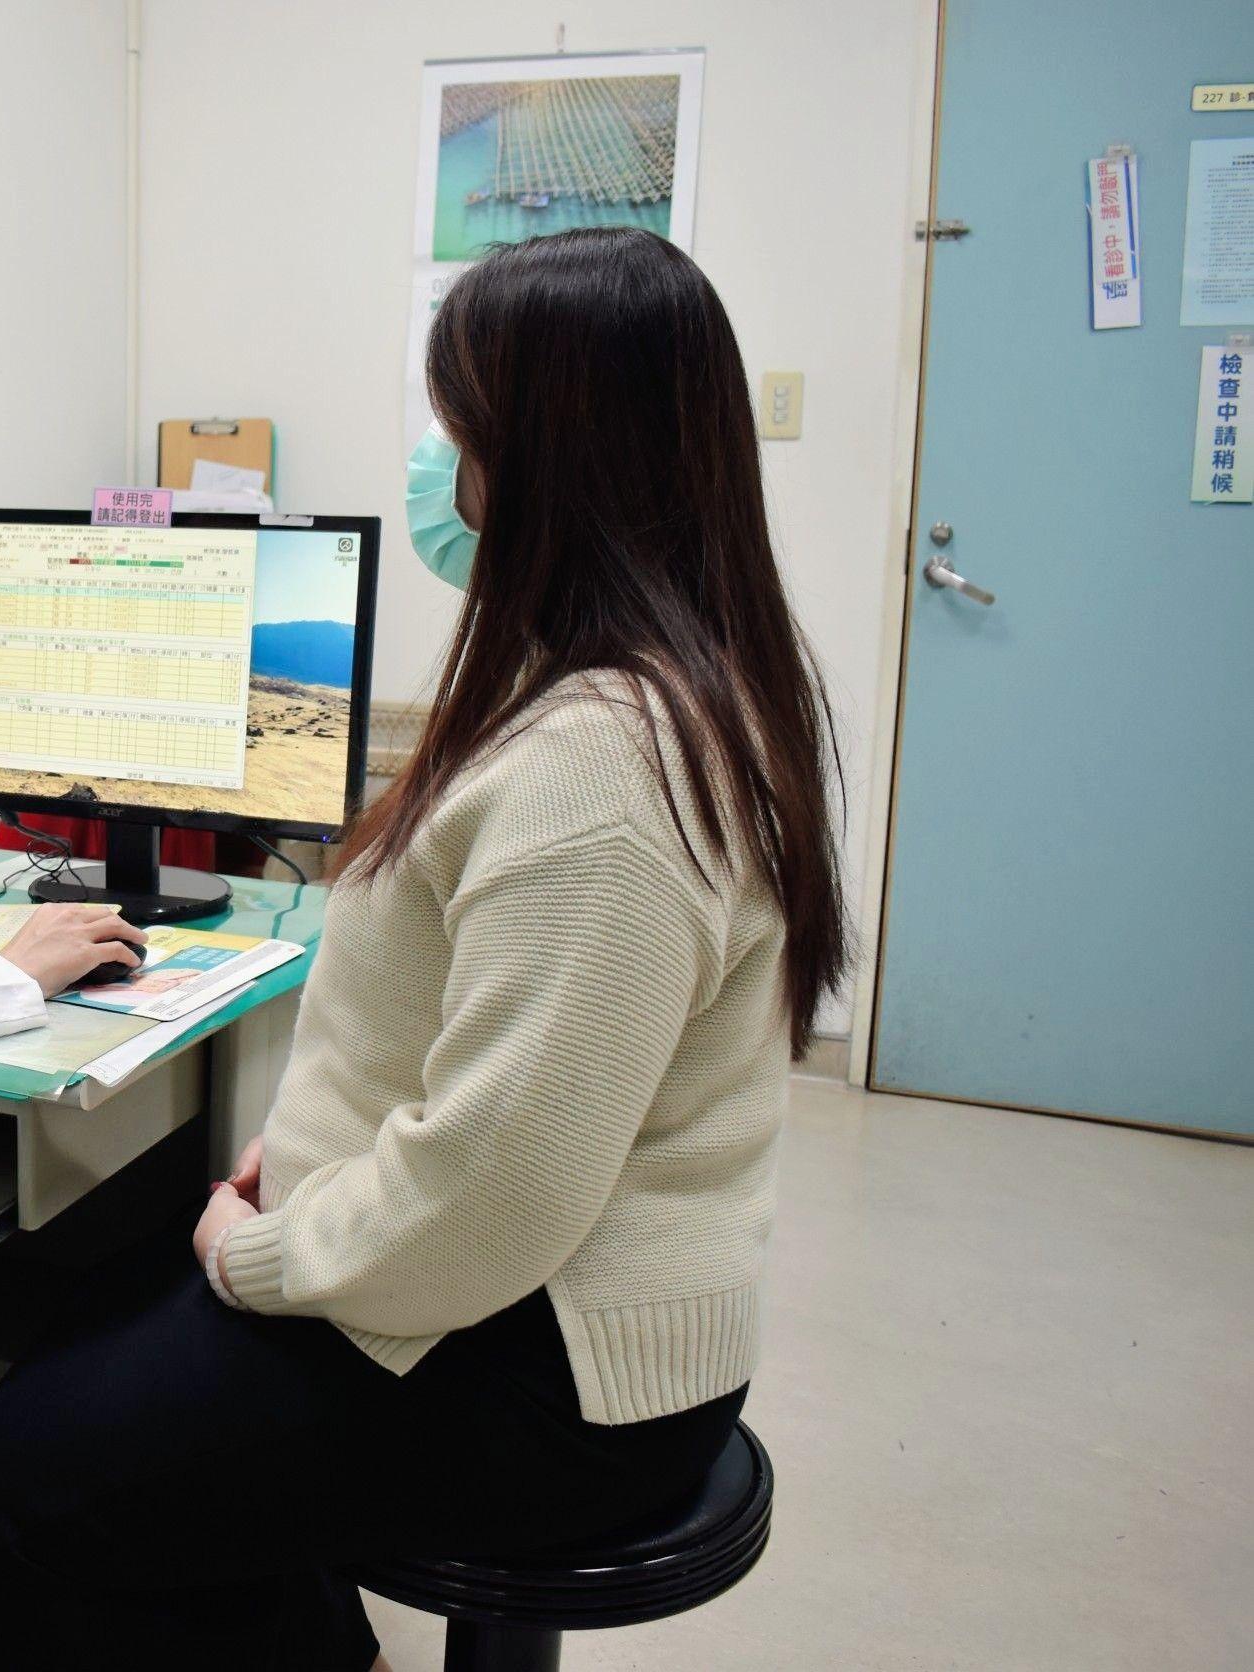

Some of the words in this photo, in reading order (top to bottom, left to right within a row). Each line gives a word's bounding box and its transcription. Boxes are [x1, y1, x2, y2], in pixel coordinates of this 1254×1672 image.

[1202, 93, 1223, 103] 227
[1210, 353, 1243, 494] 檢查中請稍候
[112, 492, 153, 508] 使用完
[97, 507, 165, 525] 請記得登出
